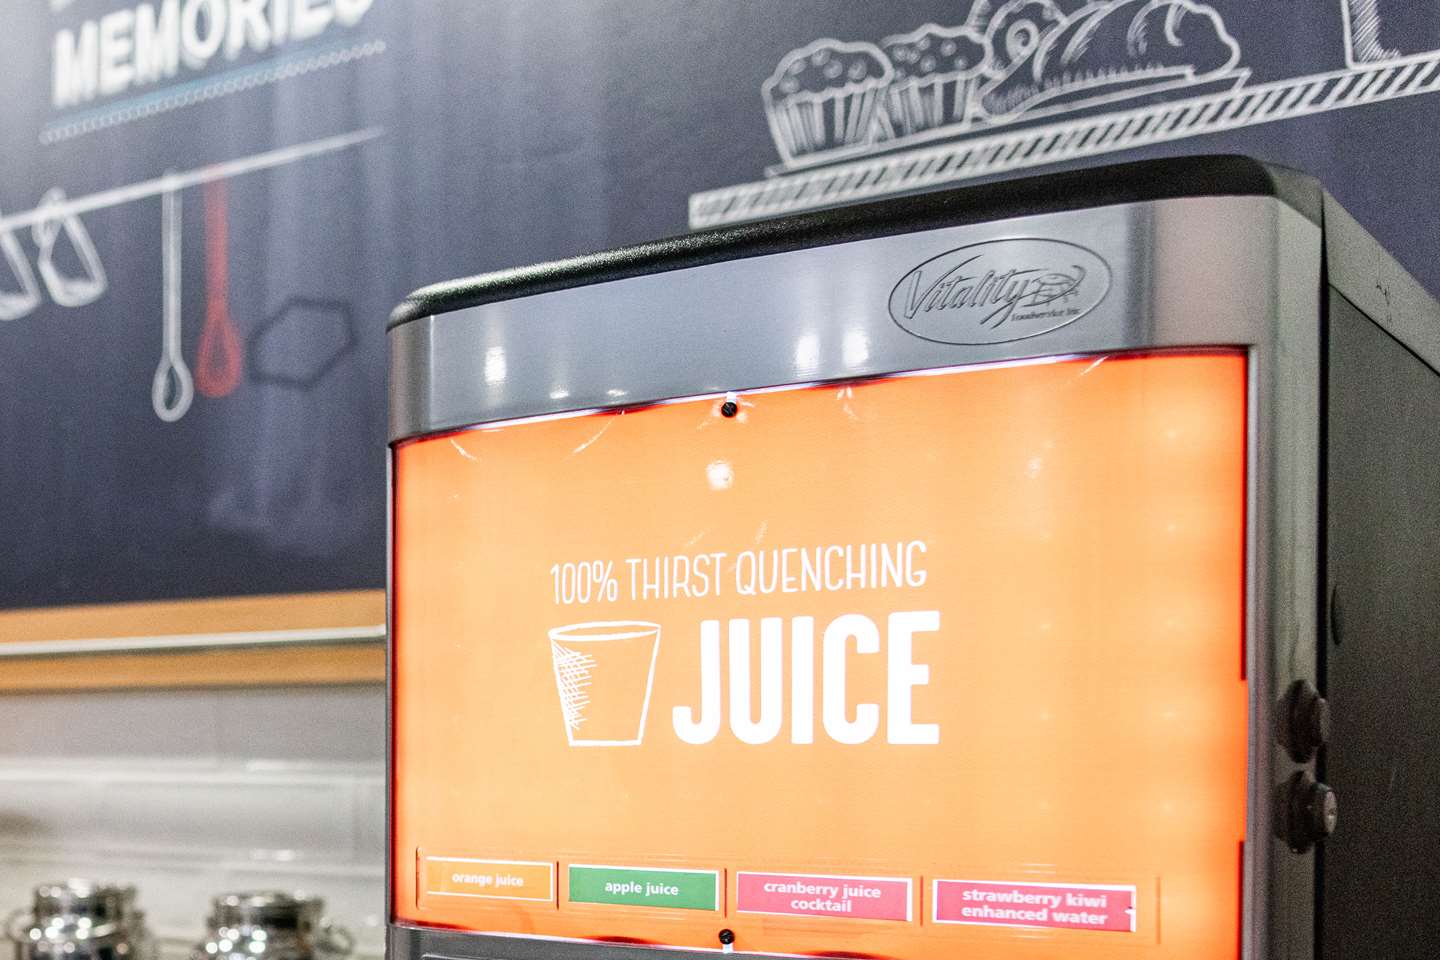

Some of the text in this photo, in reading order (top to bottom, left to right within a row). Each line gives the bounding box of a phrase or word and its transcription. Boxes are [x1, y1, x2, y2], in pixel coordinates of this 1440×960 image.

[904, 254, 1048, 329] Vitality
[550, 540, 927, 605] 100% THIRST QUENCHING
[672, 610, 941, 745] JUICE
[452, 872, 524, 888] orange juice
[605, 881, 679, 897] apple juice
[764, 881, 881, 901] cranberry juice
[962, 888, 1107, 908] strawberry kiwi
[791, 898, 852, 913] cocktail
[961, 905, 1108, 925] enhanced water
